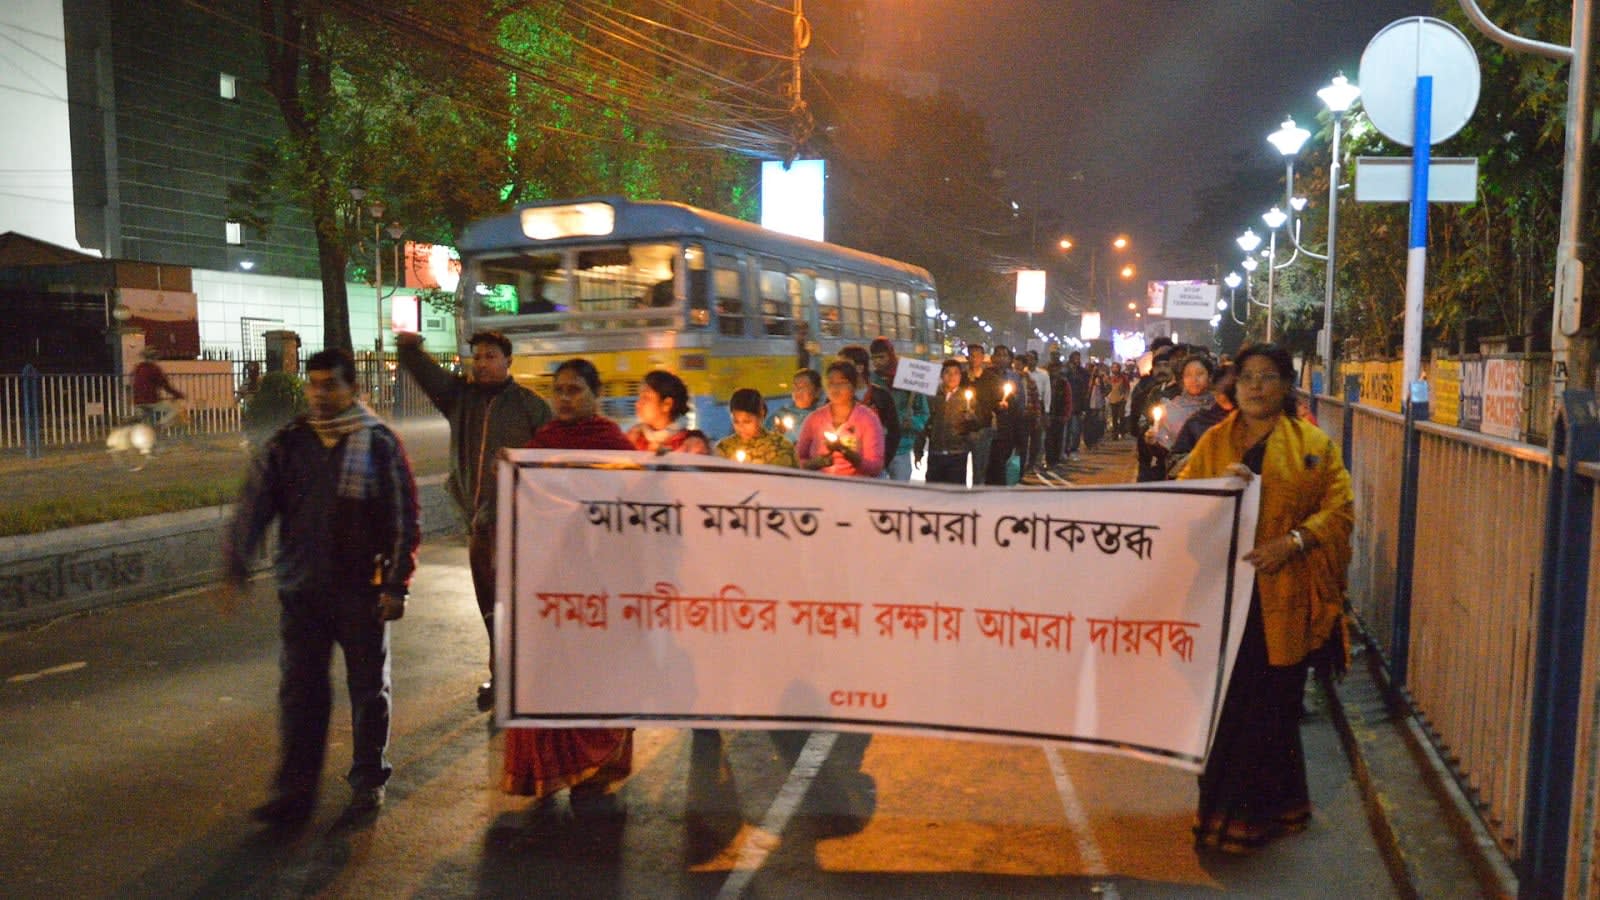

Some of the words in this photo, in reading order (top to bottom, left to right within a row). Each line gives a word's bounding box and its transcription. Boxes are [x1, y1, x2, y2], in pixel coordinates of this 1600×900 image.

[580, 498, 685, 536] আমরা
[695, 490, 824, 539] মর্মাহত
[867, 507, 981, 547] আমরা
[994, 513, 1161, 561] শোকস্তব্ধ
[536, 591, 609, 631] সমগ্র
[619, 581, 779, 633] নারীজাতির
[873, 601, 966, 643] রক্ষায়
[974, 607, 1075, 653] আমরা
[1086, 616, 1201, 663] দায়বদ্ধ
[829, 690, 889, 710] CITU
